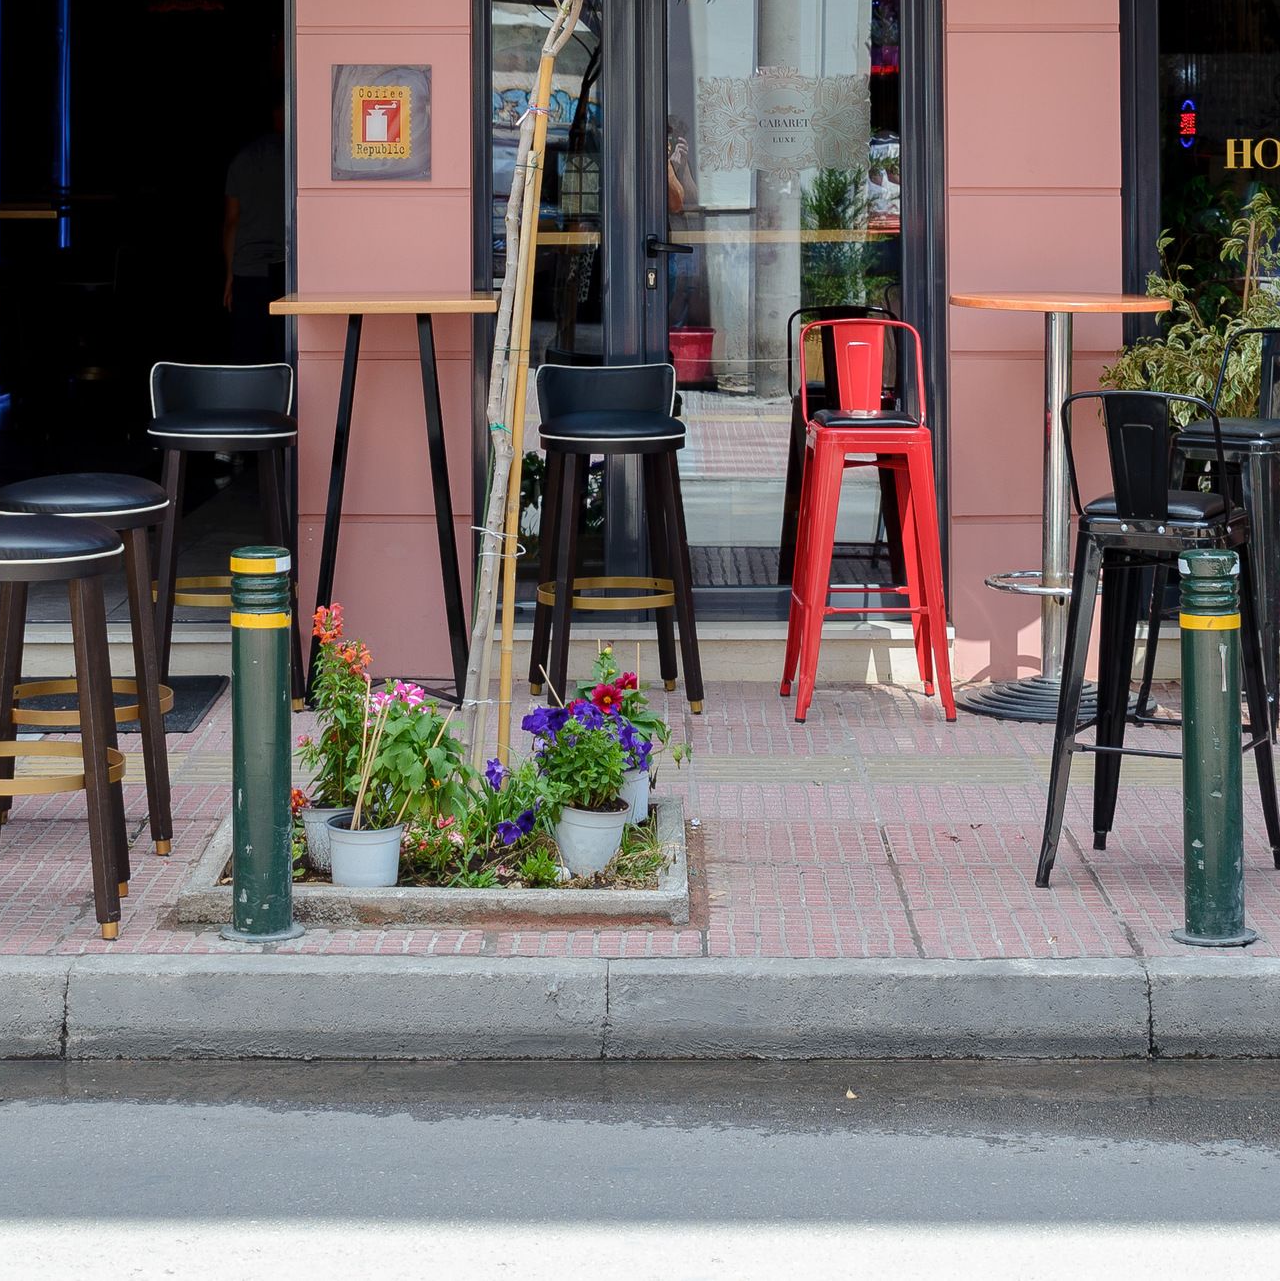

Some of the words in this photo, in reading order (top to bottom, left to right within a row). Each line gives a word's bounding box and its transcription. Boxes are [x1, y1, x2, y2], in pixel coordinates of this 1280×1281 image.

[358, 88, 404, 99] Coffee
[758, 118, 811, 128] CABARET
[356, 143, 405, 157] Republic
